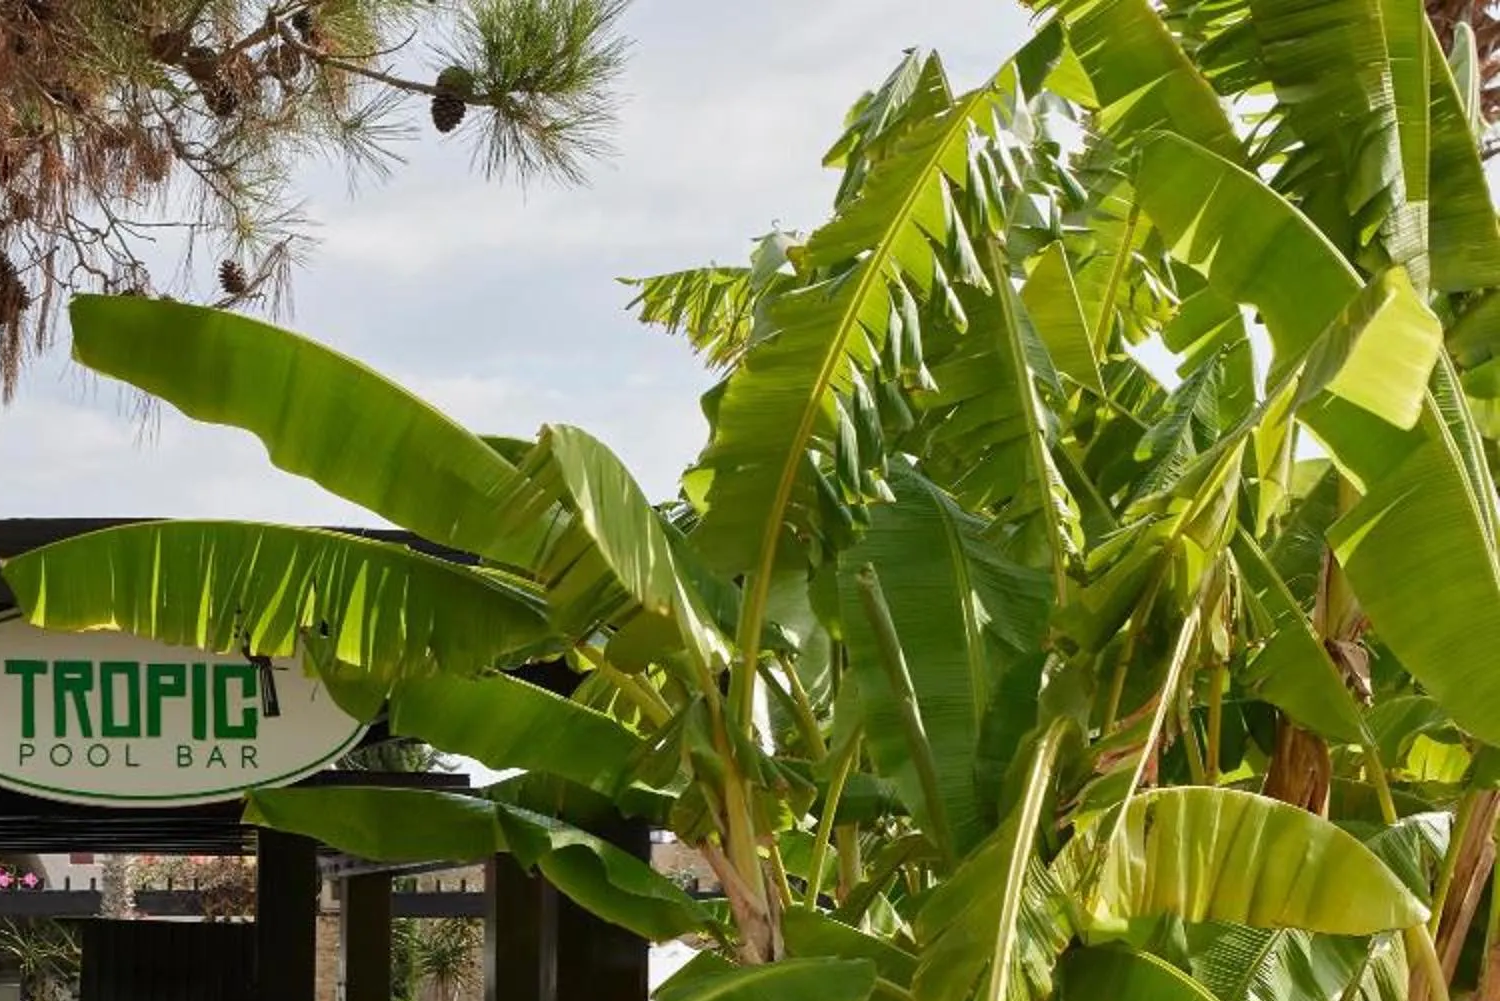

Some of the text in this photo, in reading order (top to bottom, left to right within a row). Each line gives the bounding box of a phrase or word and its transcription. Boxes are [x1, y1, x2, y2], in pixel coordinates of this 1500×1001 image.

[5, 660, 258, 740] TROPIC
[19, 743, 259, 769] POOL BAR
